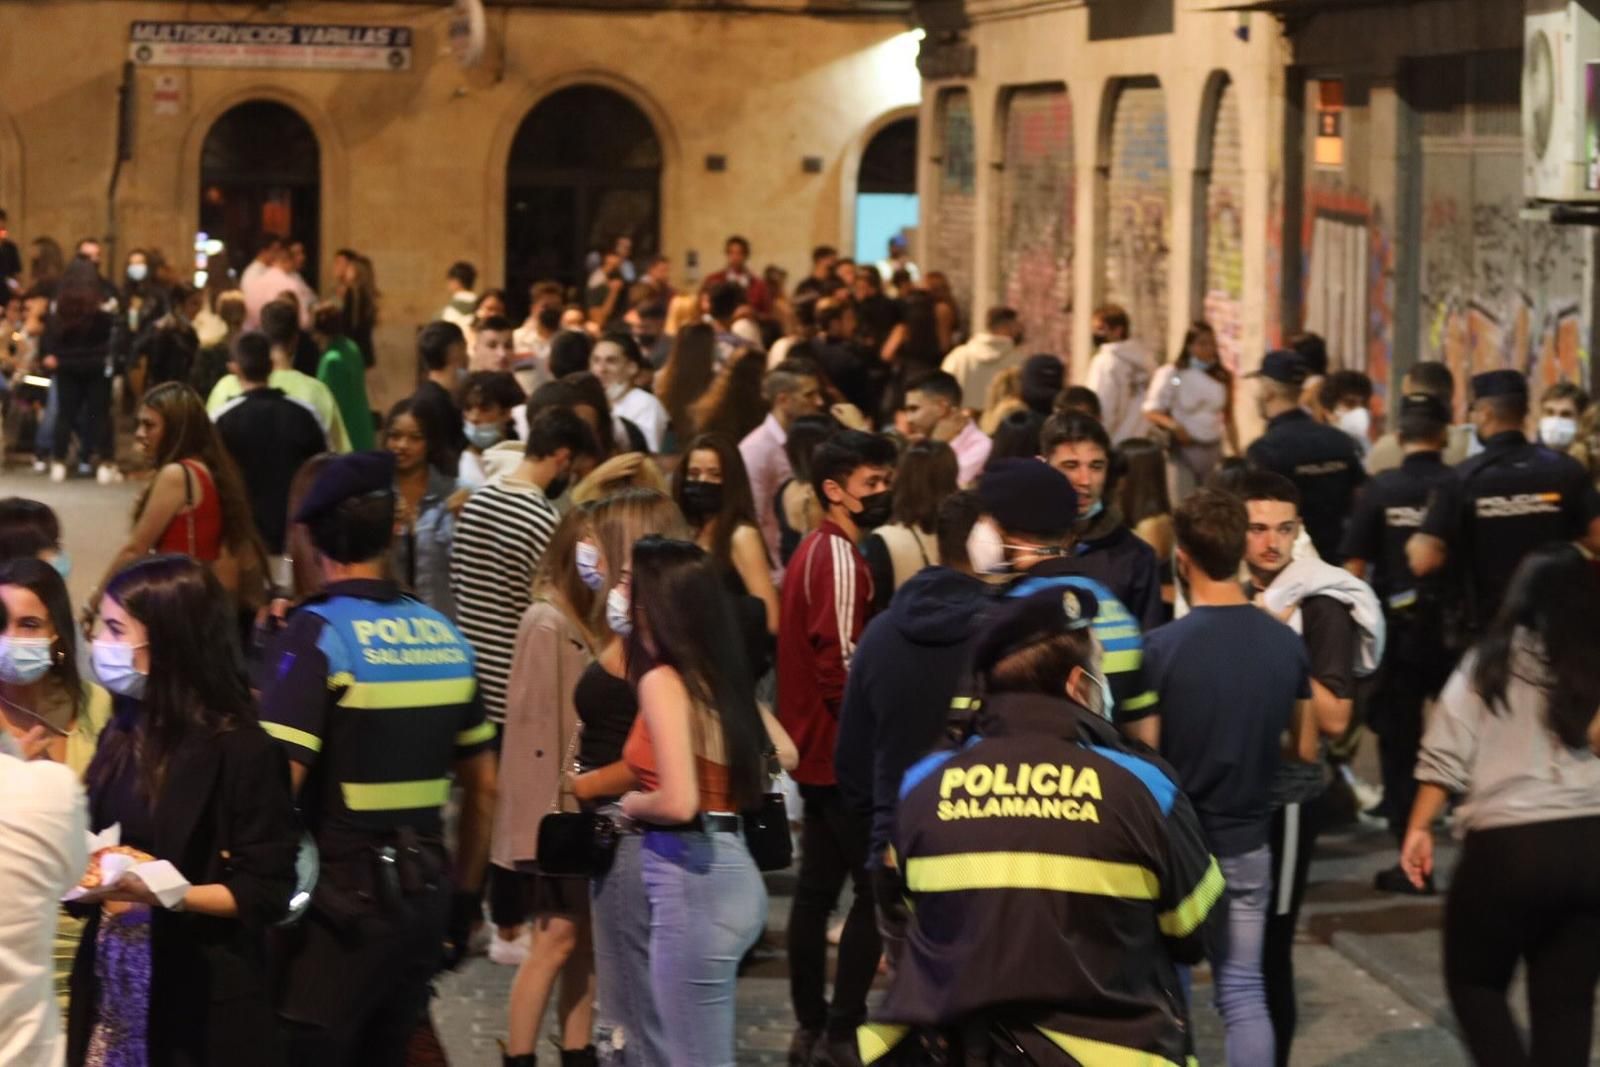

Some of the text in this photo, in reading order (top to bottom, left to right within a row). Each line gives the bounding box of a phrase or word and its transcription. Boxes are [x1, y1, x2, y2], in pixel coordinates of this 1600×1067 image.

[300, 26, 390, 45] VARILLAS
[939, 763, 1102, 800] POLICIA
[936, 797, 1100, 823] SALAMANCA
